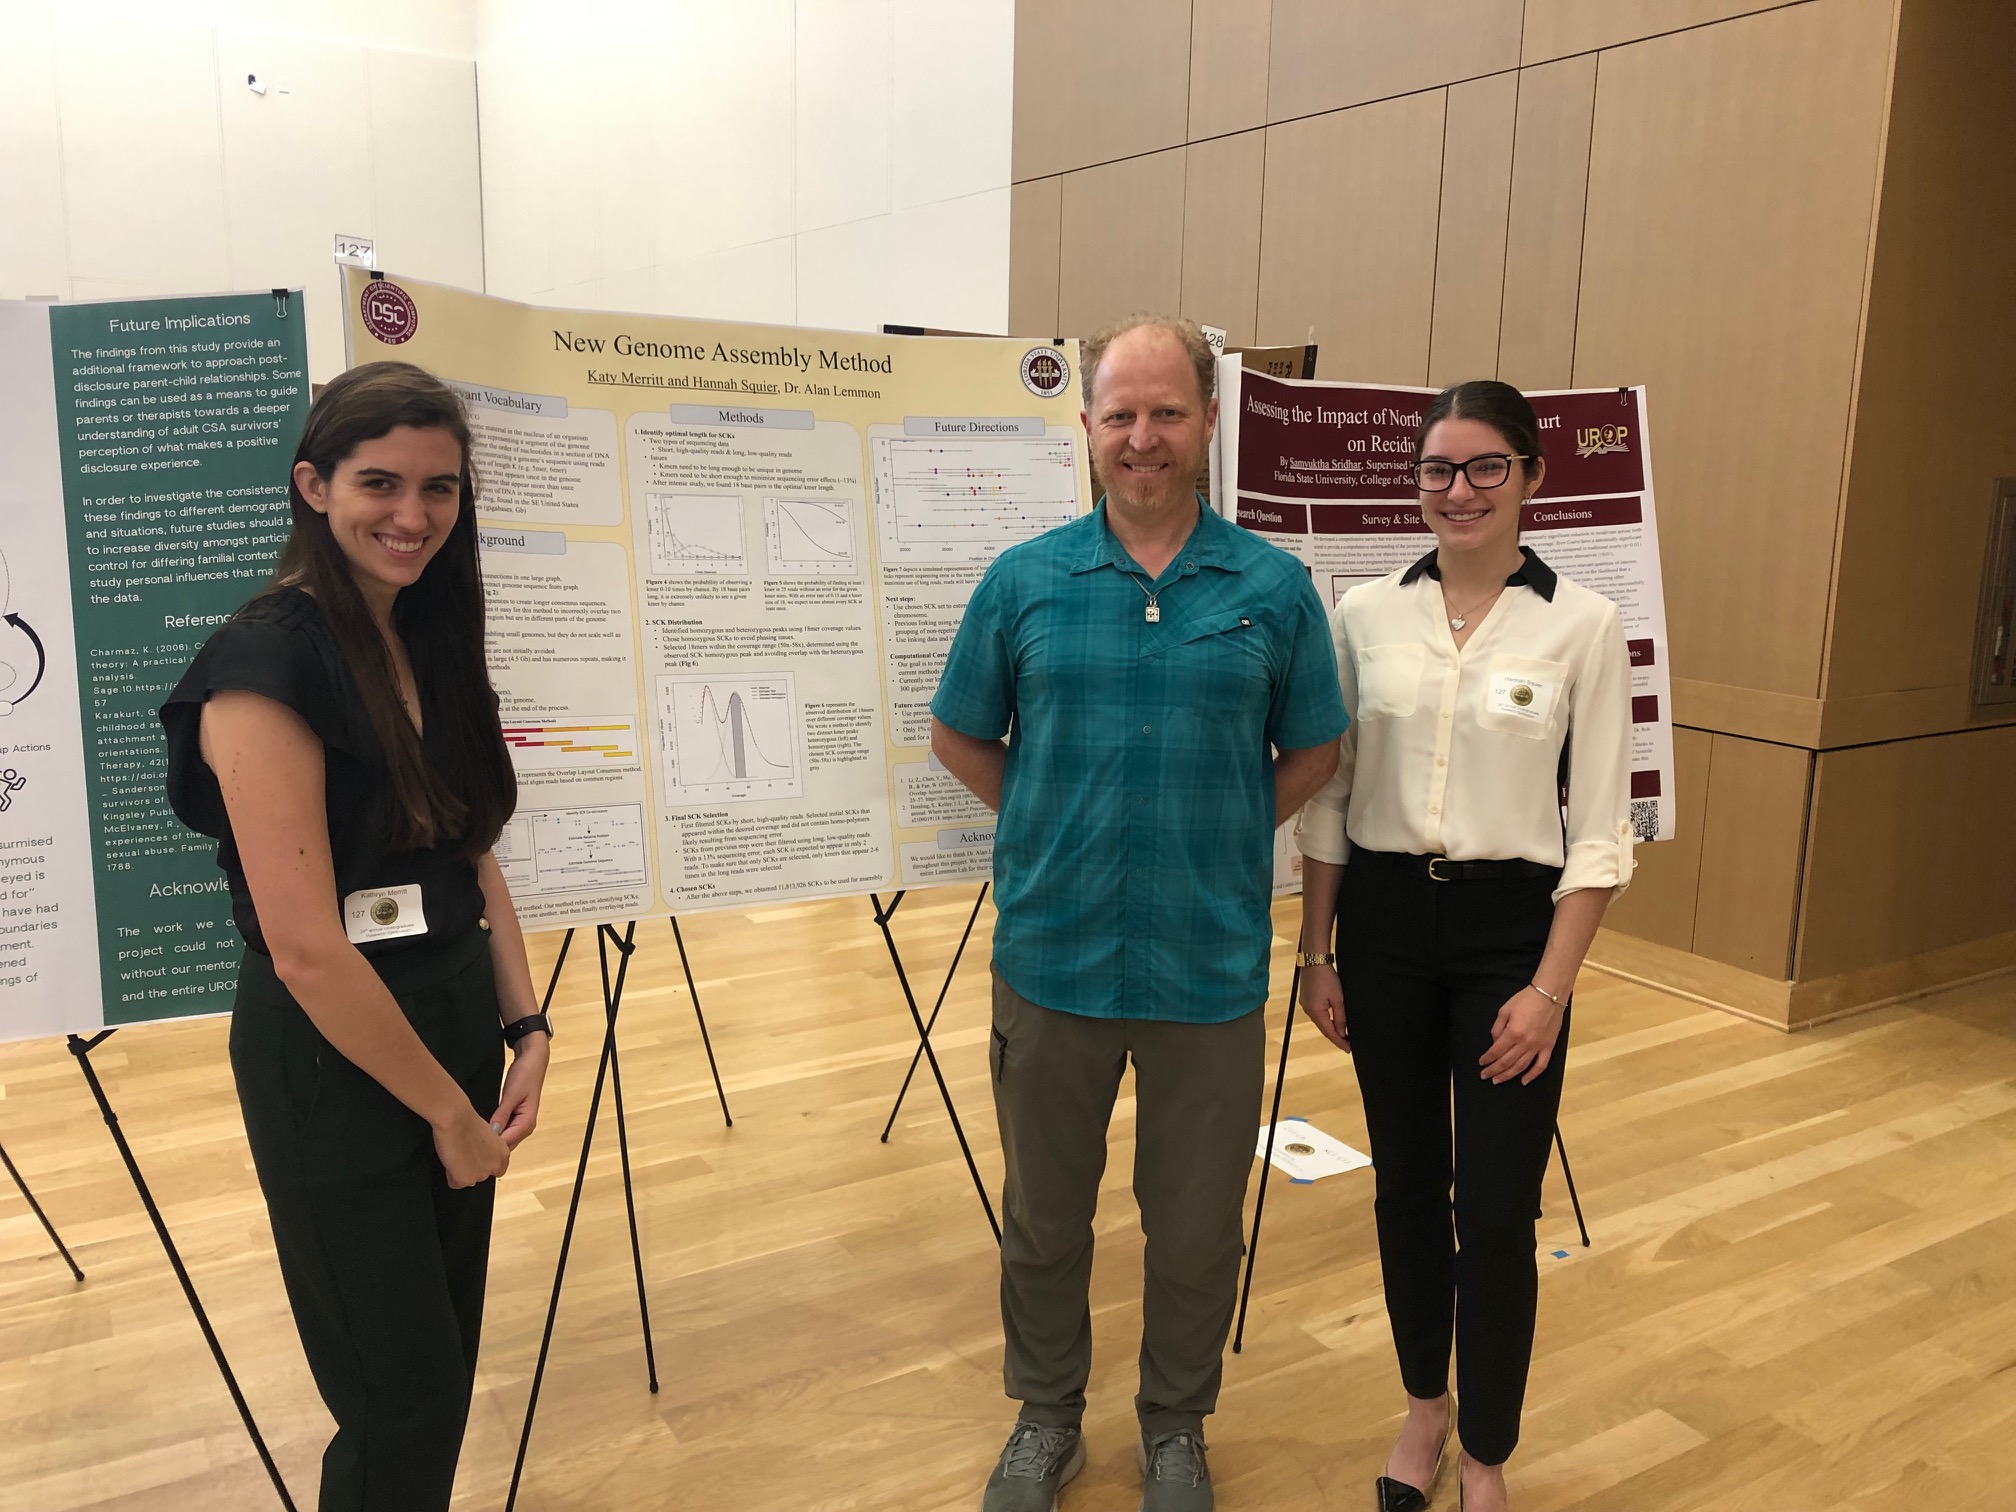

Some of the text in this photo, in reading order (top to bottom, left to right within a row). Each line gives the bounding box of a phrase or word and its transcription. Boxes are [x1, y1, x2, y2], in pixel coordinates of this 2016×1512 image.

[339, 242, 370, 259] 127
[372, 301, 405, 325] DSC
[406, 301, 417, 336] COMPUTING
[109, 314, 250, 333] Future Implications
[71, 349, 92, 358] The
[96, 347, 136, 358] findings
[140, 345, 165, 355] from
[168, 343, 187, 353] this
[191, 341, 220, 352] study
[224, 338, 263, 351] provide
[552, 330, 892, 374] New Genome Assembly Method
[72, 354, 287, 375] additional framework to approach post-
[74, 370, 301, 391] disclosure parent-child relationships. Some
[588, 370, 881, 398] Katy Merritt and Hannah Squier, Dr. Alan Lemmon
[75, 398, 116, 409] findings
[120, 397, 139, 405] can
[142, 395, 156, 404] be
[160, 392, 186, 403] used
[216, 390, 252, 398] means
[255, 388, 267, 396] to
[270, 386, 297, 398] guide
[453, 389, 542, 413] evant Vocabulary
[76, 414, 119, 426] parents
[122, 414, 133, 422] or
[137, 409, 190, 421] therapists
[194, 405, 239, 416] towards
[253, 404, 290, 414] deeper
[718, 410, 764, 424] Methods
[1247, 394, 1562, 429] Assessing the Impact of North urt
[77, 418, 280, 440] understanding of adult CSA survivors'
[934, 422, 1019, 432] Future Directions
[1576, 424, 1628, 447] UROP
[79, 446, 138, 459] perception
[142, 443, 152, 453] of
[157, 442, 183, 452] what
[187, 440, 222, 450] makes
[236, 437, 278, 449] positive
[1348, 438, 1366, 452] on
[80, 459, 202, 473] disclosure experience.
[1280, 456, 1288, 468] By
[1332, 459, 1364, 471] Sridhar,
[1366, 460, 1408, 472] Supervised
[1274, 470, 1415, 487] Florida State University, College of Soc
[1237, 508, 1282, 524] search Question
[1362, 514, 1420, 527] Survey & Site
[1534, 509, 1592, 522] Conclusions
[476, 532, 526, 548] kground
[165, 614, 232, 628] Referenc
[90, 644, 190, 657] Charmaz, K. (2006).
[91, 662, 128, 670] theory:
[143, 656, 186, 668] practical
[13, 742, 51, 753] Actions
[104, 824, 163, 834] McElvaney,
[0, 836, 53, 850] surmised
[150, 878, 230, 898] Acknowle
[360, 888, 407, 898] Kathryn Merritt
[2, 902, 59, 918] have had
[352, 910, 365, 918] 127
[117, 920, 214, 938] The work we
[118, 939, 234, 961] project could not
[120, 960, 240, 980] without our mentor,
[122, 990, 144, 1002] and
[148, 988, 168, 999] the
[171, 984, 205, 996] entire
